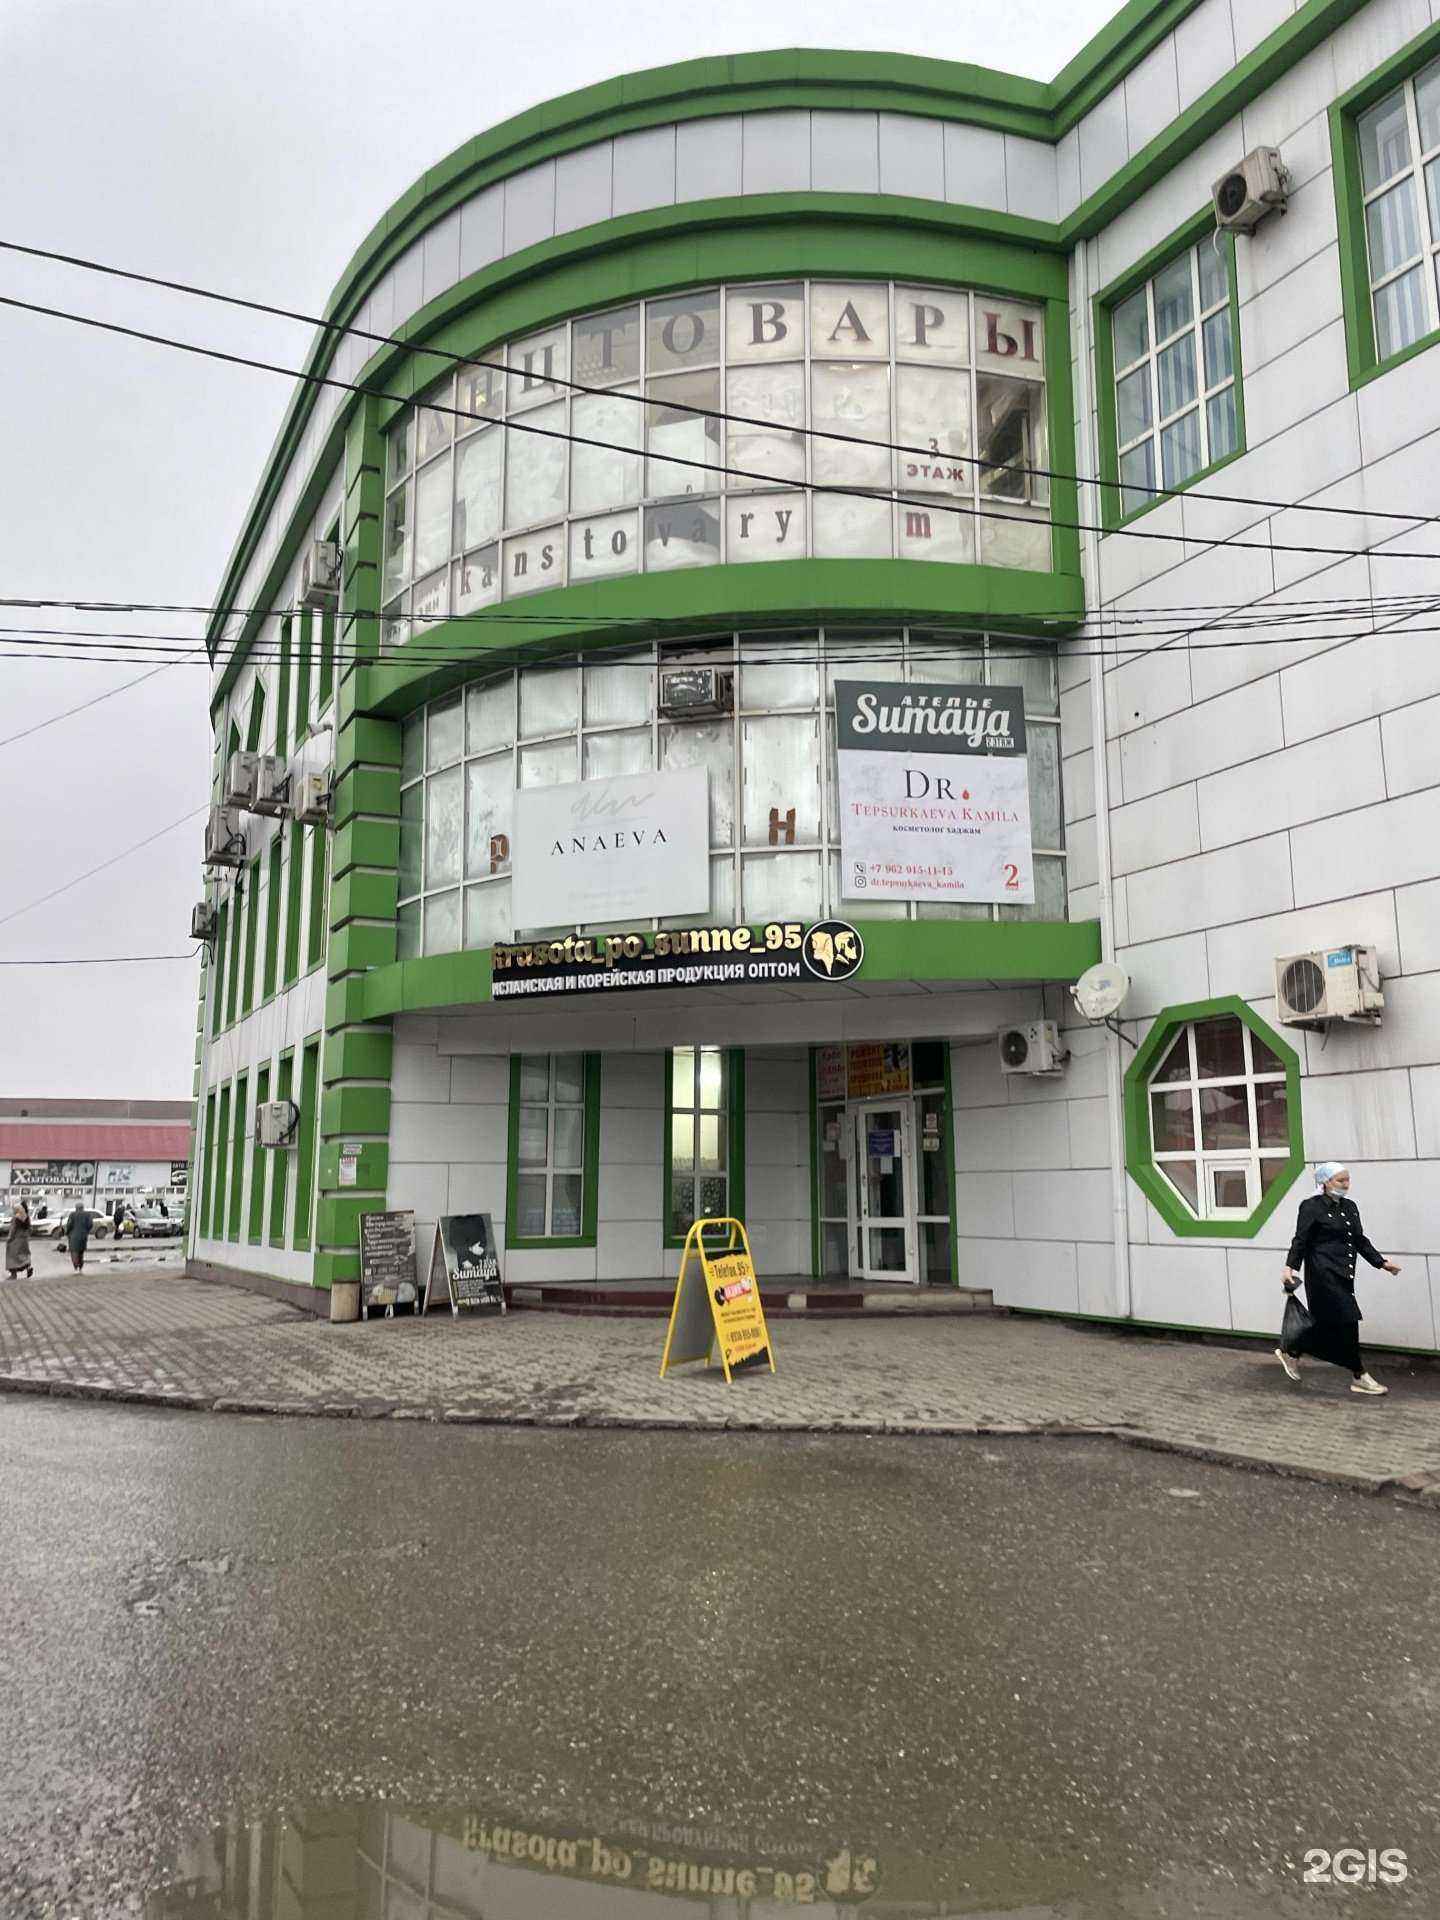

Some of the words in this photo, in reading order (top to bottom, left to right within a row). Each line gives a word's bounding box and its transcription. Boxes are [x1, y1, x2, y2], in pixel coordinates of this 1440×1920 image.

[906, 464, 965, 482] ЭТАЖ
[852, 693, 1011, 747] Sumaya
[551, 829, 668, 856] ANAEVA
[1004, 864, 1019, 889] 2
[565, 975, 576, 989] И
[577, 968, 655, 988] КОРЕЙСКАЯ
[657, 963, 744, 984] ПРОДУКЦИЯ
[747, 962, 800, 978] ОПТОМ
